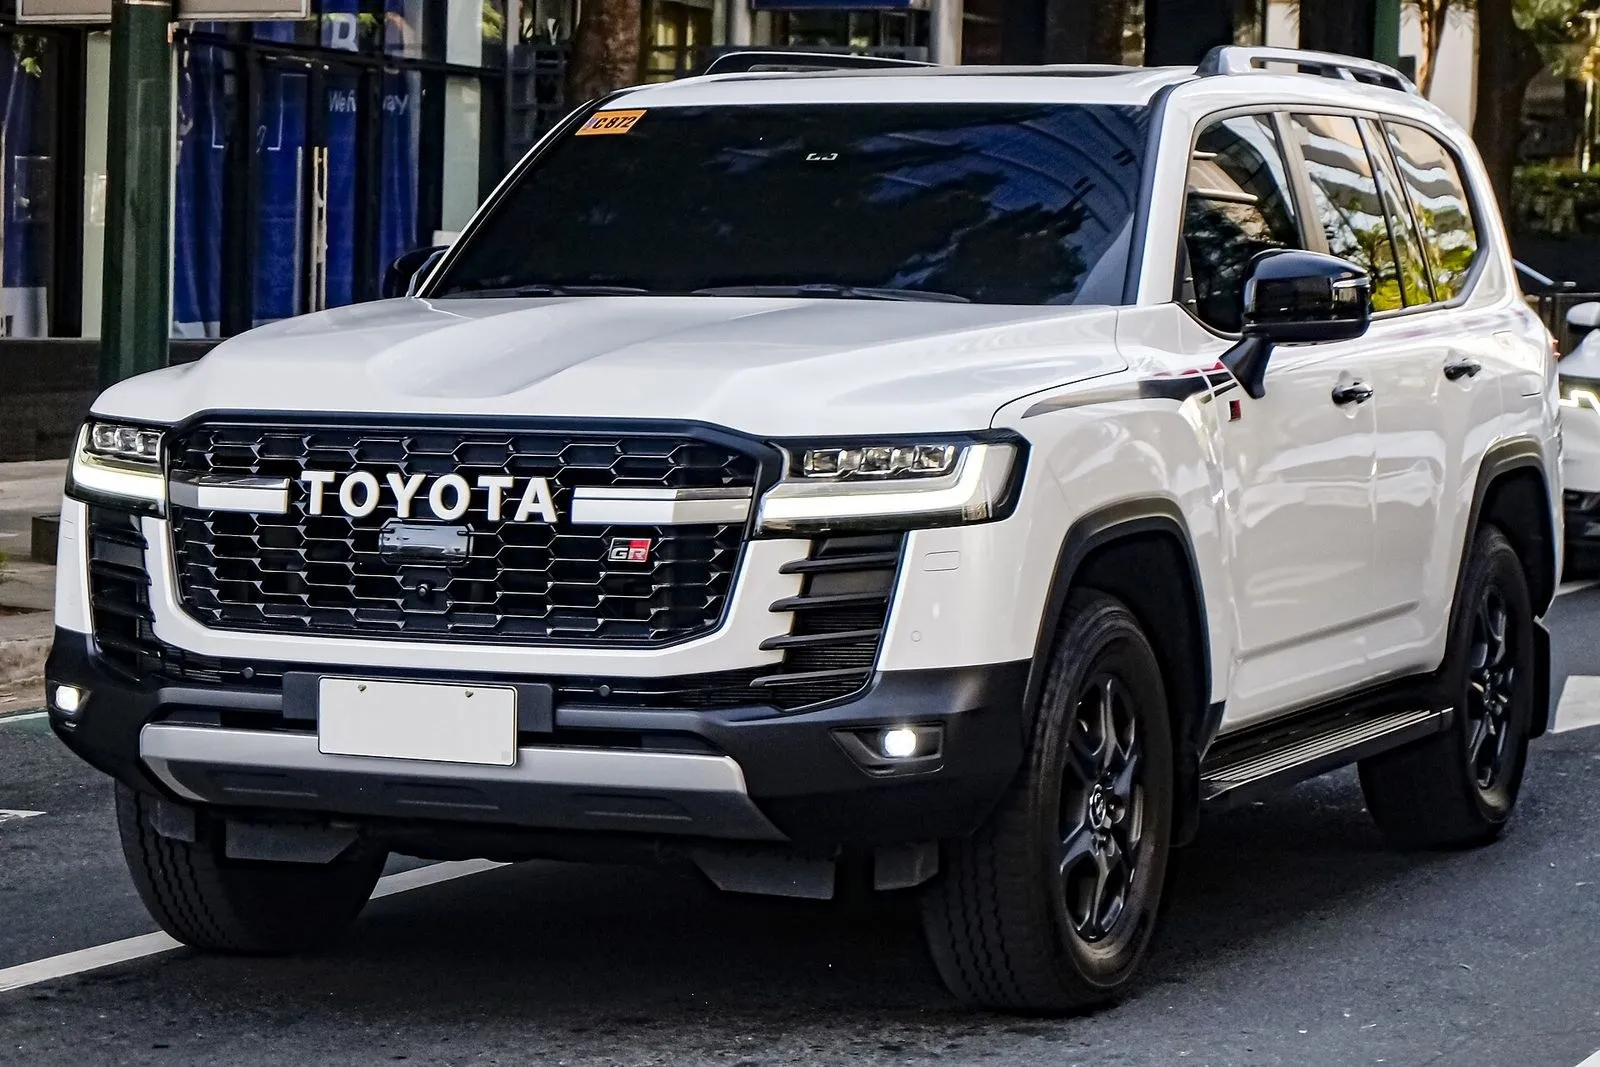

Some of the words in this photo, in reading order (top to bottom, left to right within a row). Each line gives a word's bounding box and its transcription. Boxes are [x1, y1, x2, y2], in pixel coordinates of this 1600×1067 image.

[604, 116, 638, 129] 872
[301, 471, 558, 523] TOYOTA
[609, 544, 646, 560] GR
